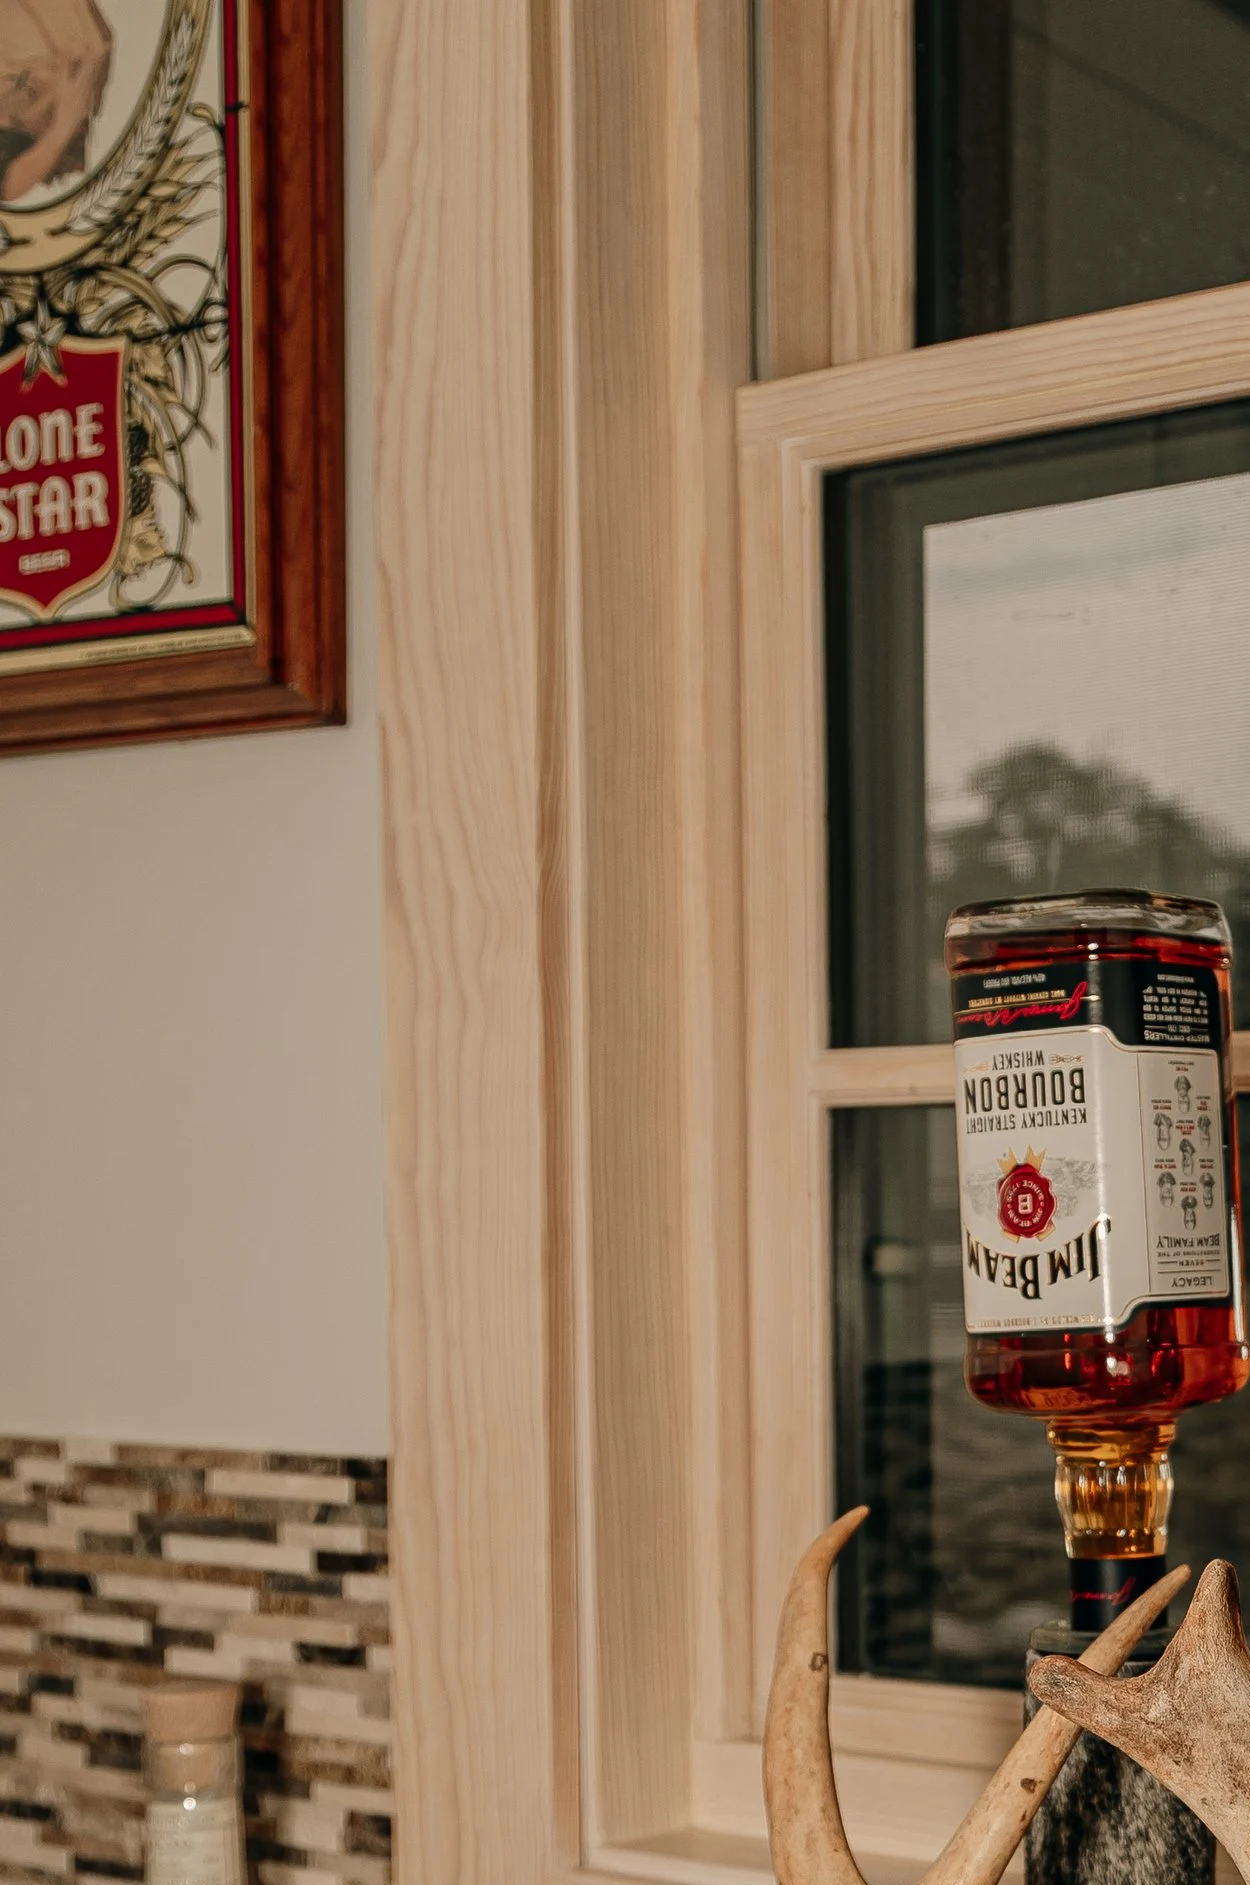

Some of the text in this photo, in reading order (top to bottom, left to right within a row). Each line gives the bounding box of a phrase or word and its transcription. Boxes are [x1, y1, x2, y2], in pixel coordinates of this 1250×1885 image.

[992, 1050, 1044, 1071] WHISKEY
[964, 1067, 1085, 1114] BOURBON
[966, 1108, 1086, 1134] KENTUCKY STRAIGHT
[1156, 1232, 1220, 1248] BEAM FAMILY
[965, 1218, 1111, 1300] JIM BEAM
[1171, 1276, 1212, 1288] LEGACY
